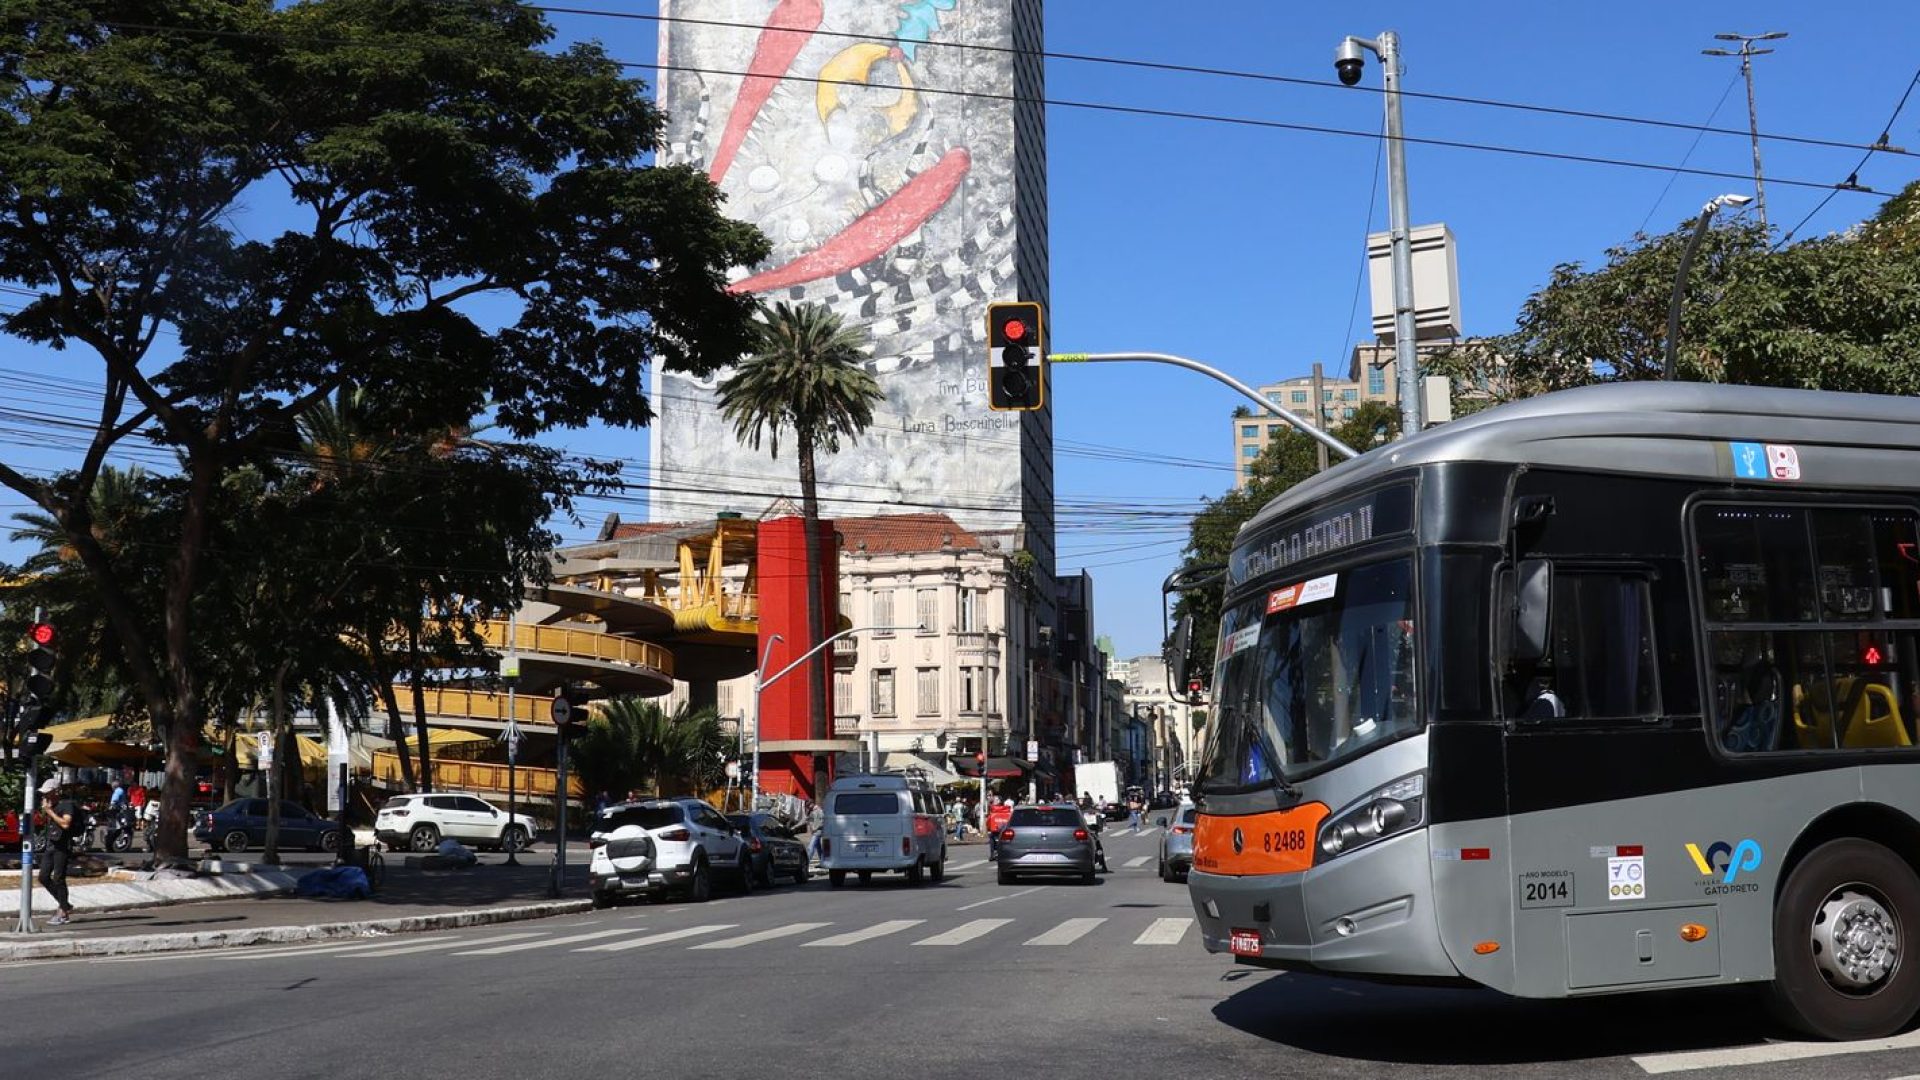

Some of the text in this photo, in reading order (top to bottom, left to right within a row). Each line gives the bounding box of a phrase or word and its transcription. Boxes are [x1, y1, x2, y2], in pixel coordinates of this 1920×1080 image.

[1264, 829, 1305, 853] 8 2488
[1526, 881, 1569, 901] 2014
[1704, 883, 1759, 896] GATO PRETO
